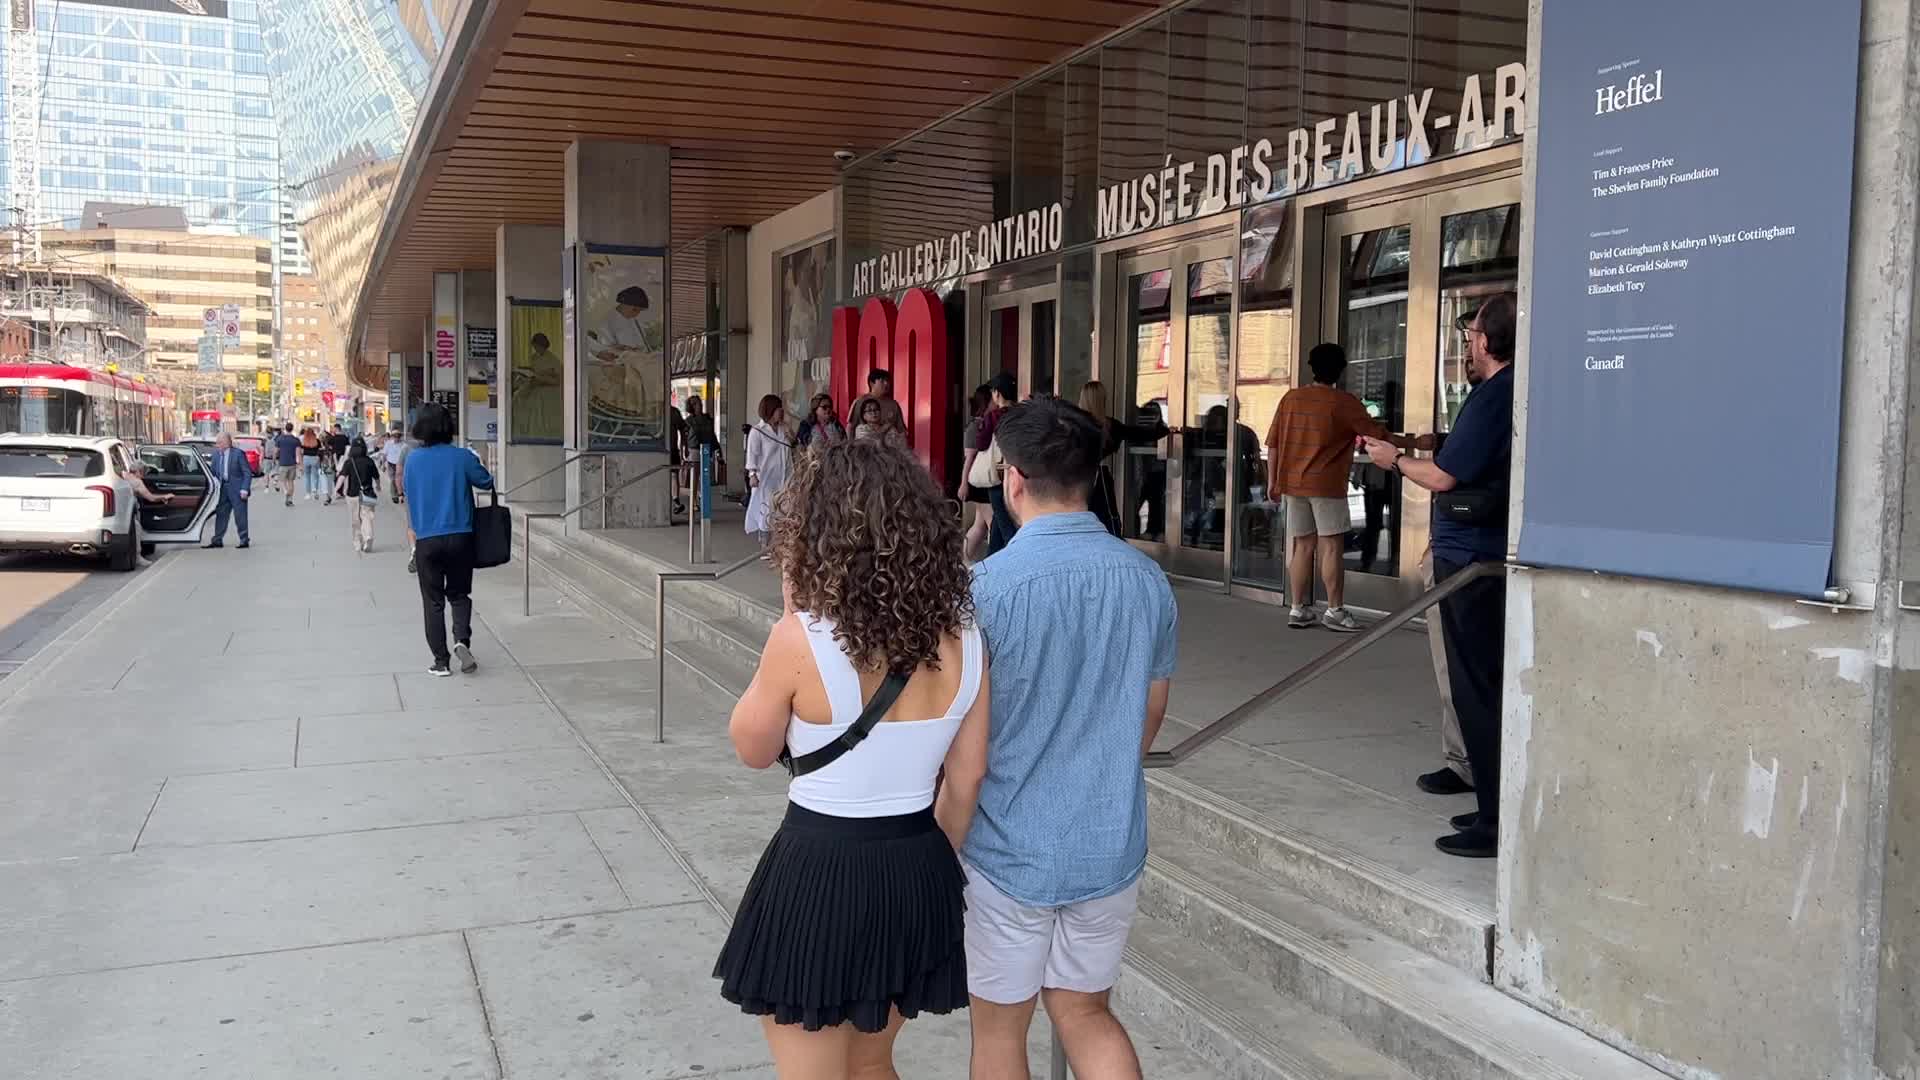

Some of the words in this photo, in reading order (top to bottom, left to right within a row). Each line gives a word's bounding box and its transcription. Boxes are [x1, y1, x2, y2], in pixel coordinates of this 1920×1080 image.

[1594, 69, 1663, 115] Heffel
[1097, 154, 1195, 238] MUSÉE
[1206, 138, 1273, 211] DES
[1287, 62, 1526, 191] BEAUX-AR
[1592, 187, 1608, 198] The
[1640, 175, 1668, 190] Family
[1669, 167, 1719, 184] Foundation
[1593, 170, 1609, 180] Tim
[1610, 168, 1617, 177] &
[1618, 163, 1651, 176] Frances
[1651, 157, 1674, 169] Price
[853, 258, 876, 297] ART
[880, 238, 945, 290] GALLERY
[949, 230, 971, 273] OF
[977, 203, 1063, 267] ONTARIO
[1590, 247, 1612, 260] David
[1613, 243, 1661, 258] Cottingham
[1662, 241, 1669, 251] &
[1671, 238, 1707, 250] Kathryn
[1709, 232, 1736, 247] Wyatt
[1737, 225, 1796, 241] Cottingham
[1589, 266, 1617, 277] Marion
[1618, 264, 1625, 274] &
[1625, 260, 1654, 273] Gerald
[1654, 258, 1689, 270] Soloway
[1588, 280, 1625, 295] Elizabeth
[1626, 280, 1646, 292] Tory
[436, 329, 455, 369] SHOP
[1585, 355, 1625, 370] Canada
